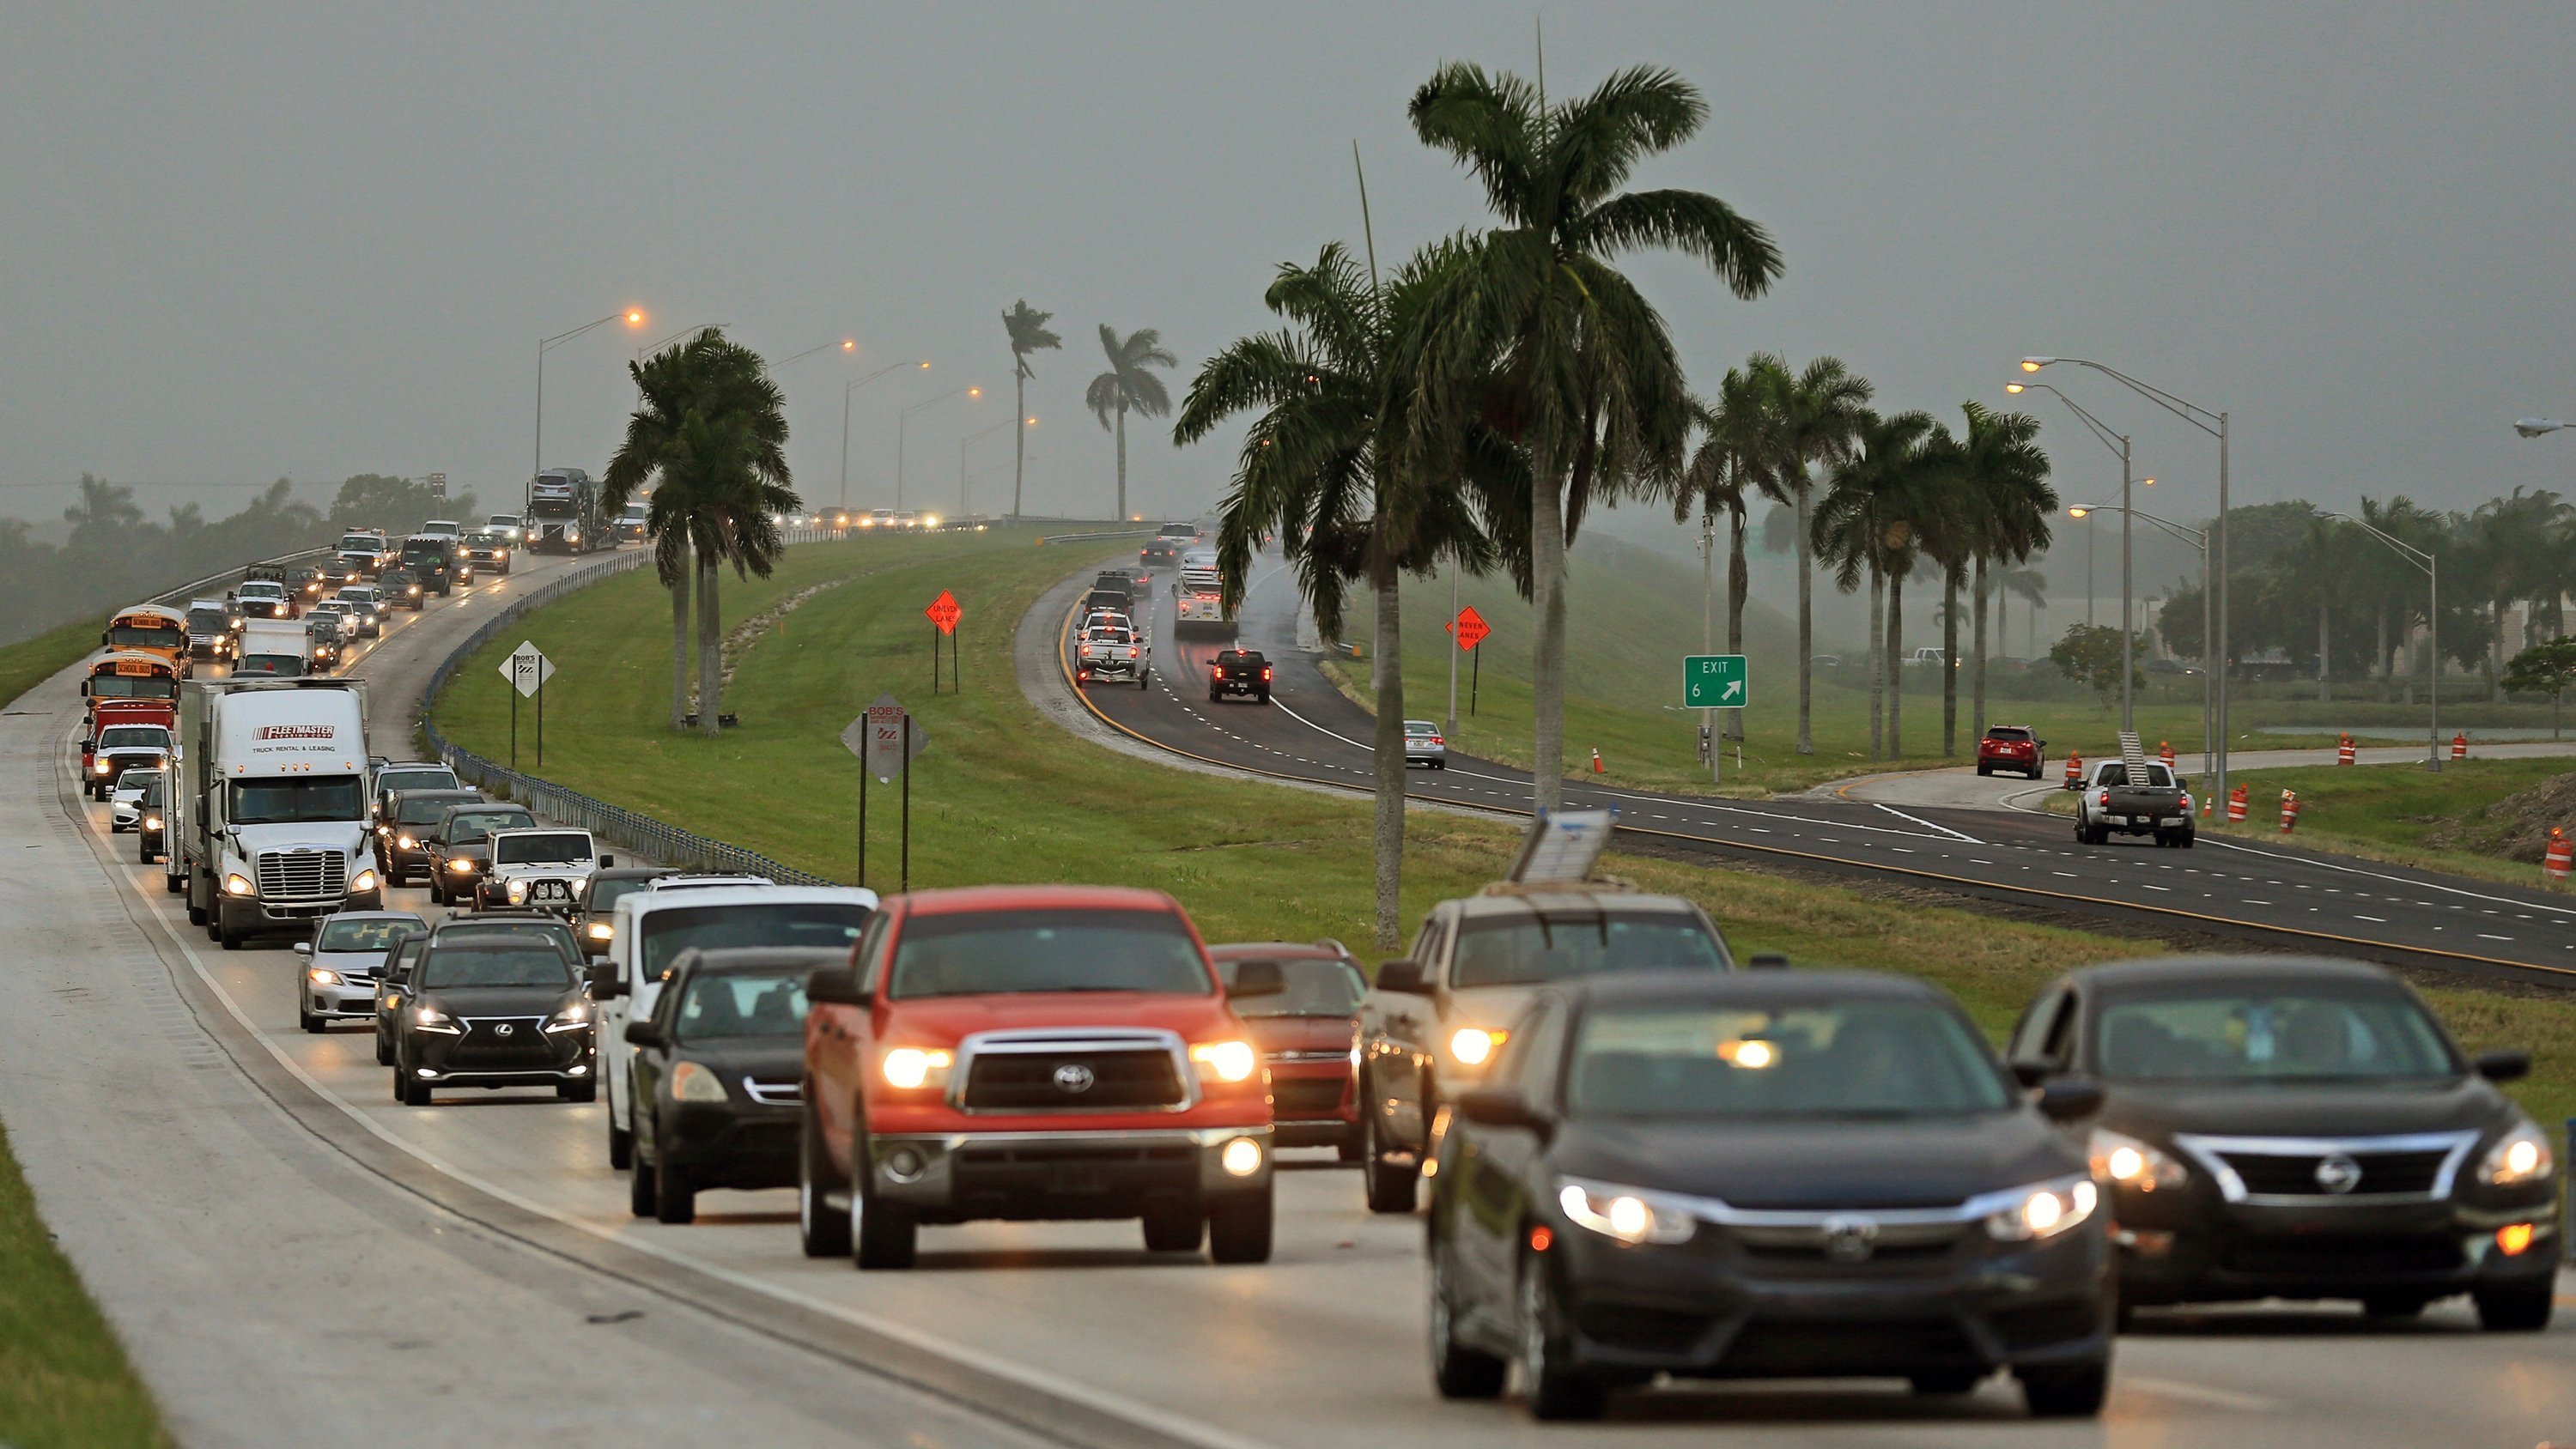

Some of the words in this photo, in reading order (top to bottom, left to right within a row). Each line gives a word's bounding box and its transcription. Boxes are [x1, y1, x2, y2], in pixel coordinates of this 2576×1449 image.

[118, 664, 137, 673] SCHOOL
[139, 665, 150, 674] BUS
[1703, 661, 1728, 674] EXIT
[1692, 683, 1700, 697] 6
[869, 706, 903, 715] BOB'S
[268, 725, 333, 738] FLEETMASTER
